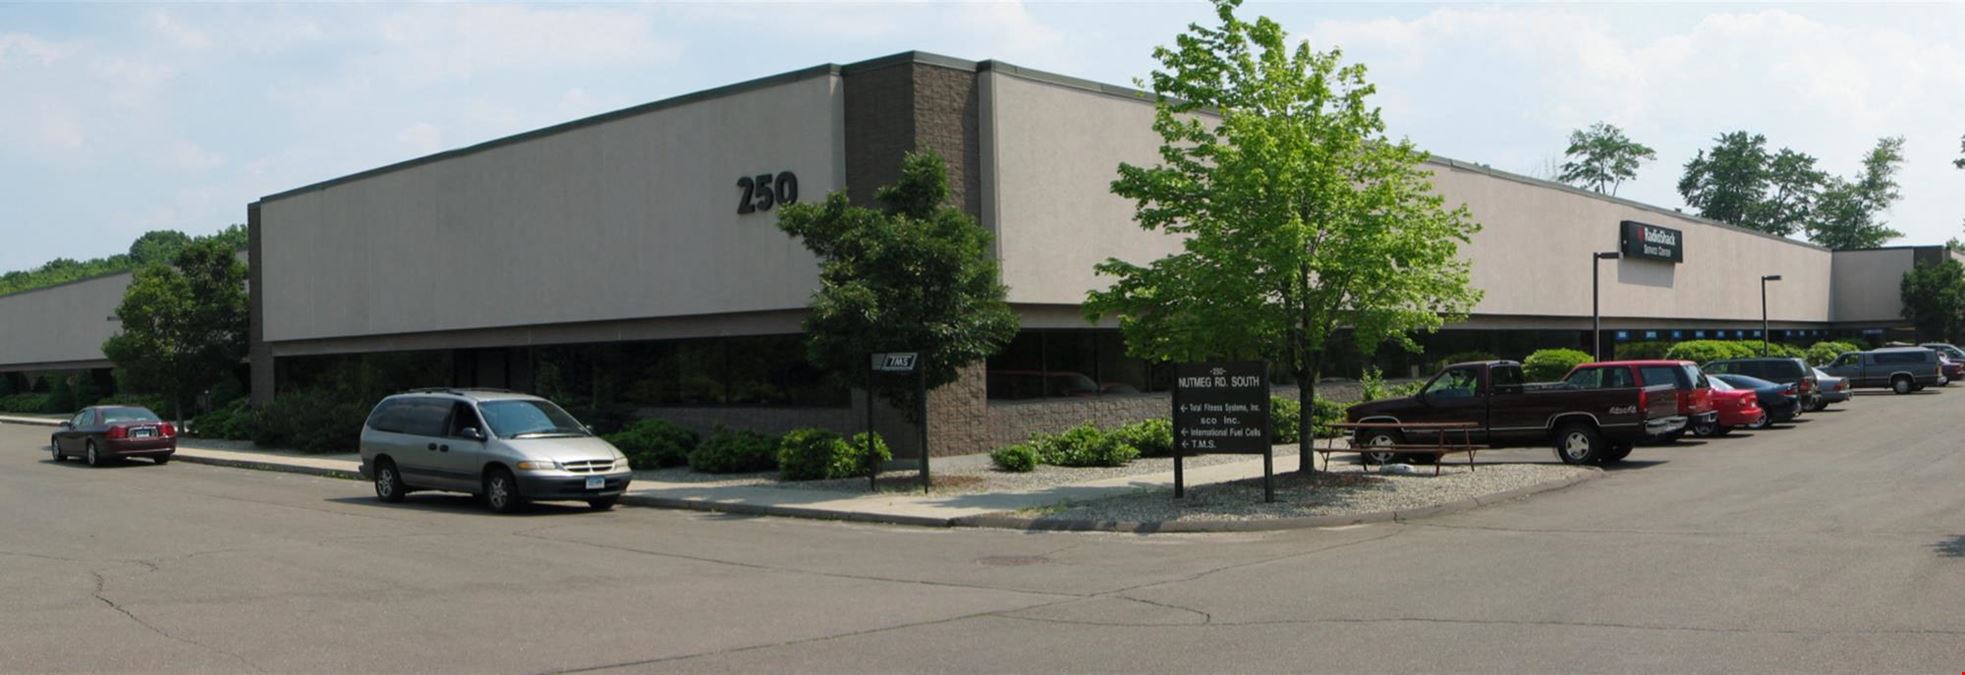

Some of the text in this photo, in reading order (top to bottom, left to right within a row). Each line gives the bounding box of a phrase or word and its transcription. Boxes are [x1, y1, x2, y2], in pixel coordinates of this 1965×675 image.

[736, 171, 798, 215] 250
[1644, 227, 1676, 246] RadioShack
[1178, 376, 1260, 388] NUTMEG RD. SOUTH
[1190, 403, 1201, 412] Total
[1204, 403, 1223, 412] Fitness
[1250, 403, 1260, 412] Inc.
[1223, 416, 1240, 425] Inc.
[1190, 428, 1261, 437] International Fuel Cells
[1191, 439, 1216, 449] T.M.S.
